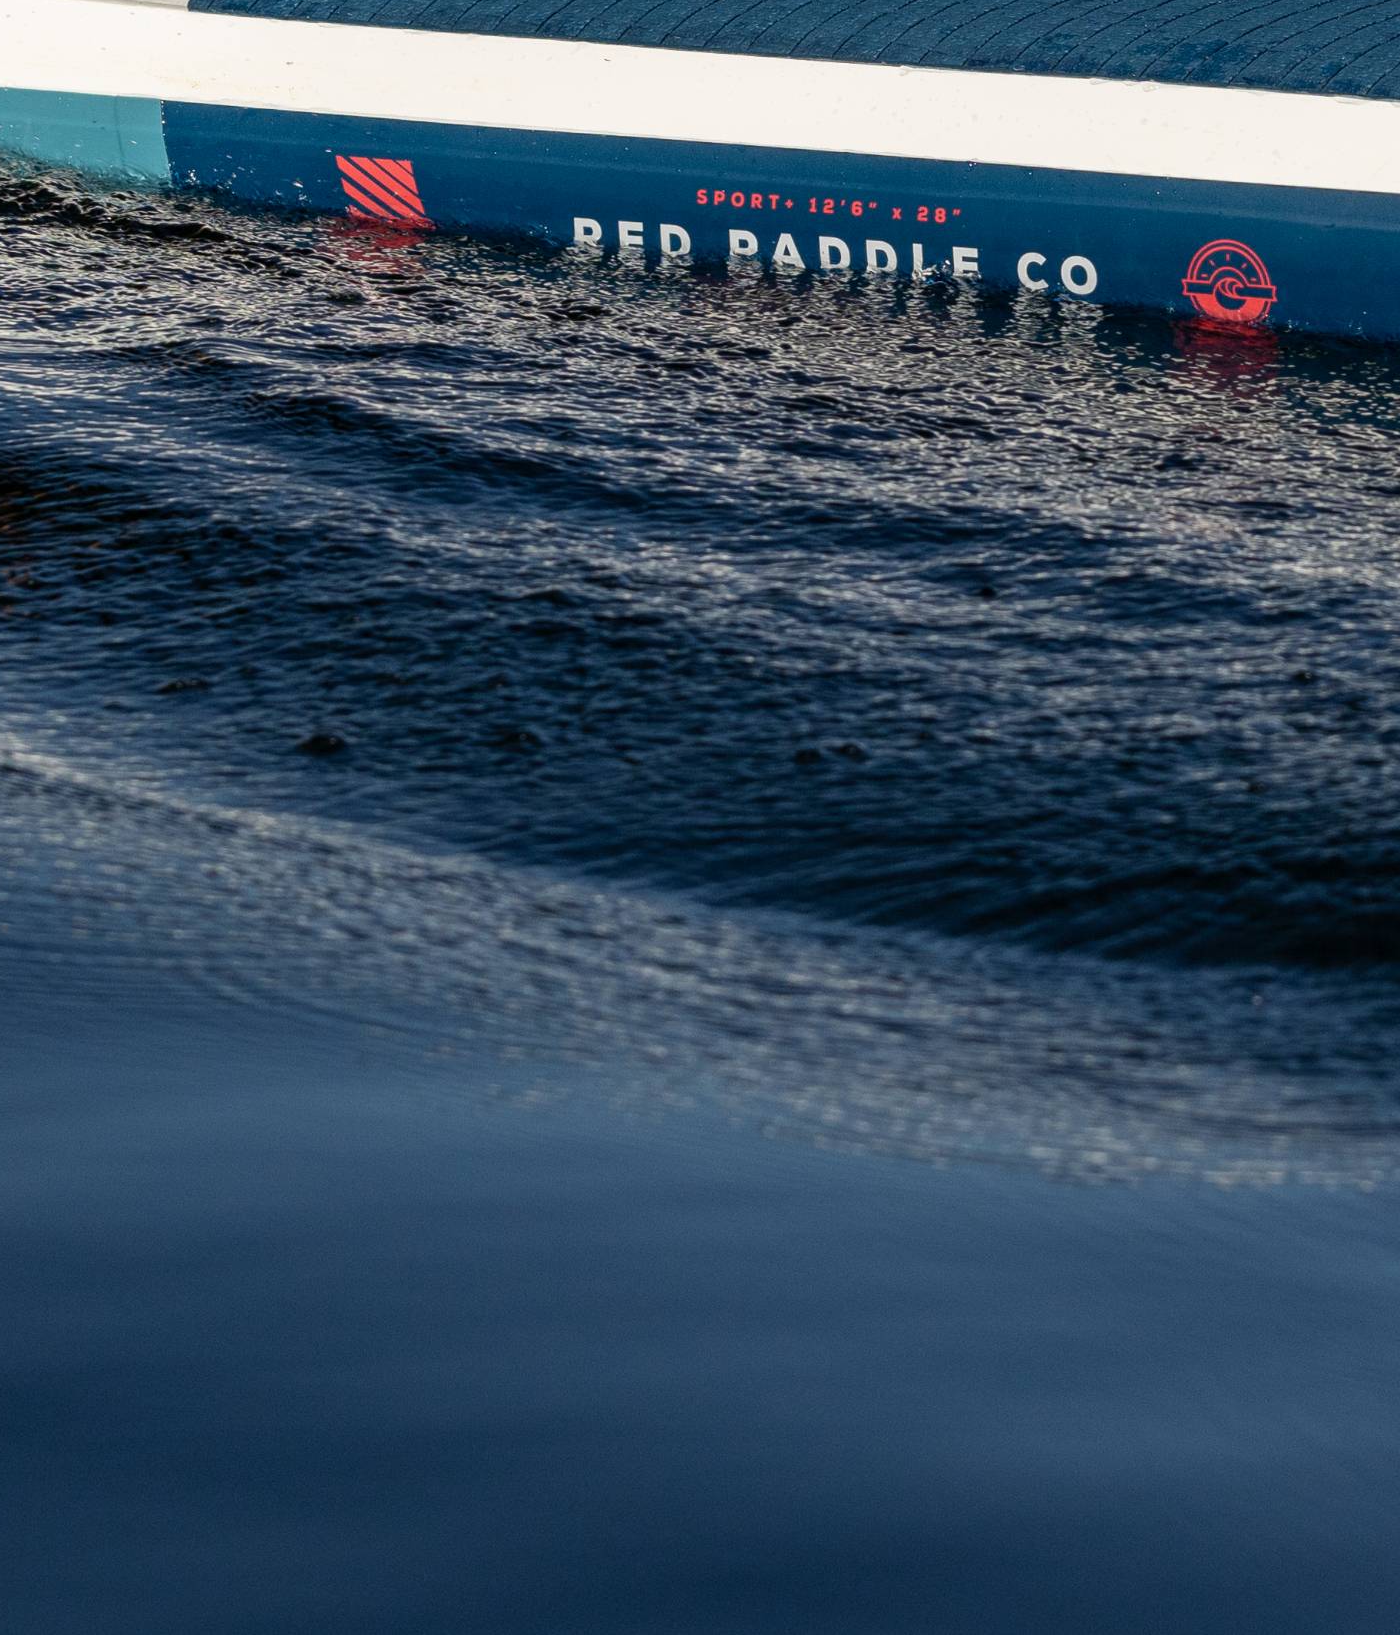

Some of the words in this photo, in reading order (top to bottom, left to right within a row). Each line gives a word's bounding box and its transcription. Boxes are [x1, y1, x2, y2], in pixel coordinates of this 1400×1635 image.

[696, 188, 795, 210] SPORT+
[808, 197, 877, 216] 12'6"
[916, 205, 961, 223] 28"
[573, 217, 692, 255] RED
[728, 228, 980, 279] PADDLE
[1017, 252, 1098, 295] CO
